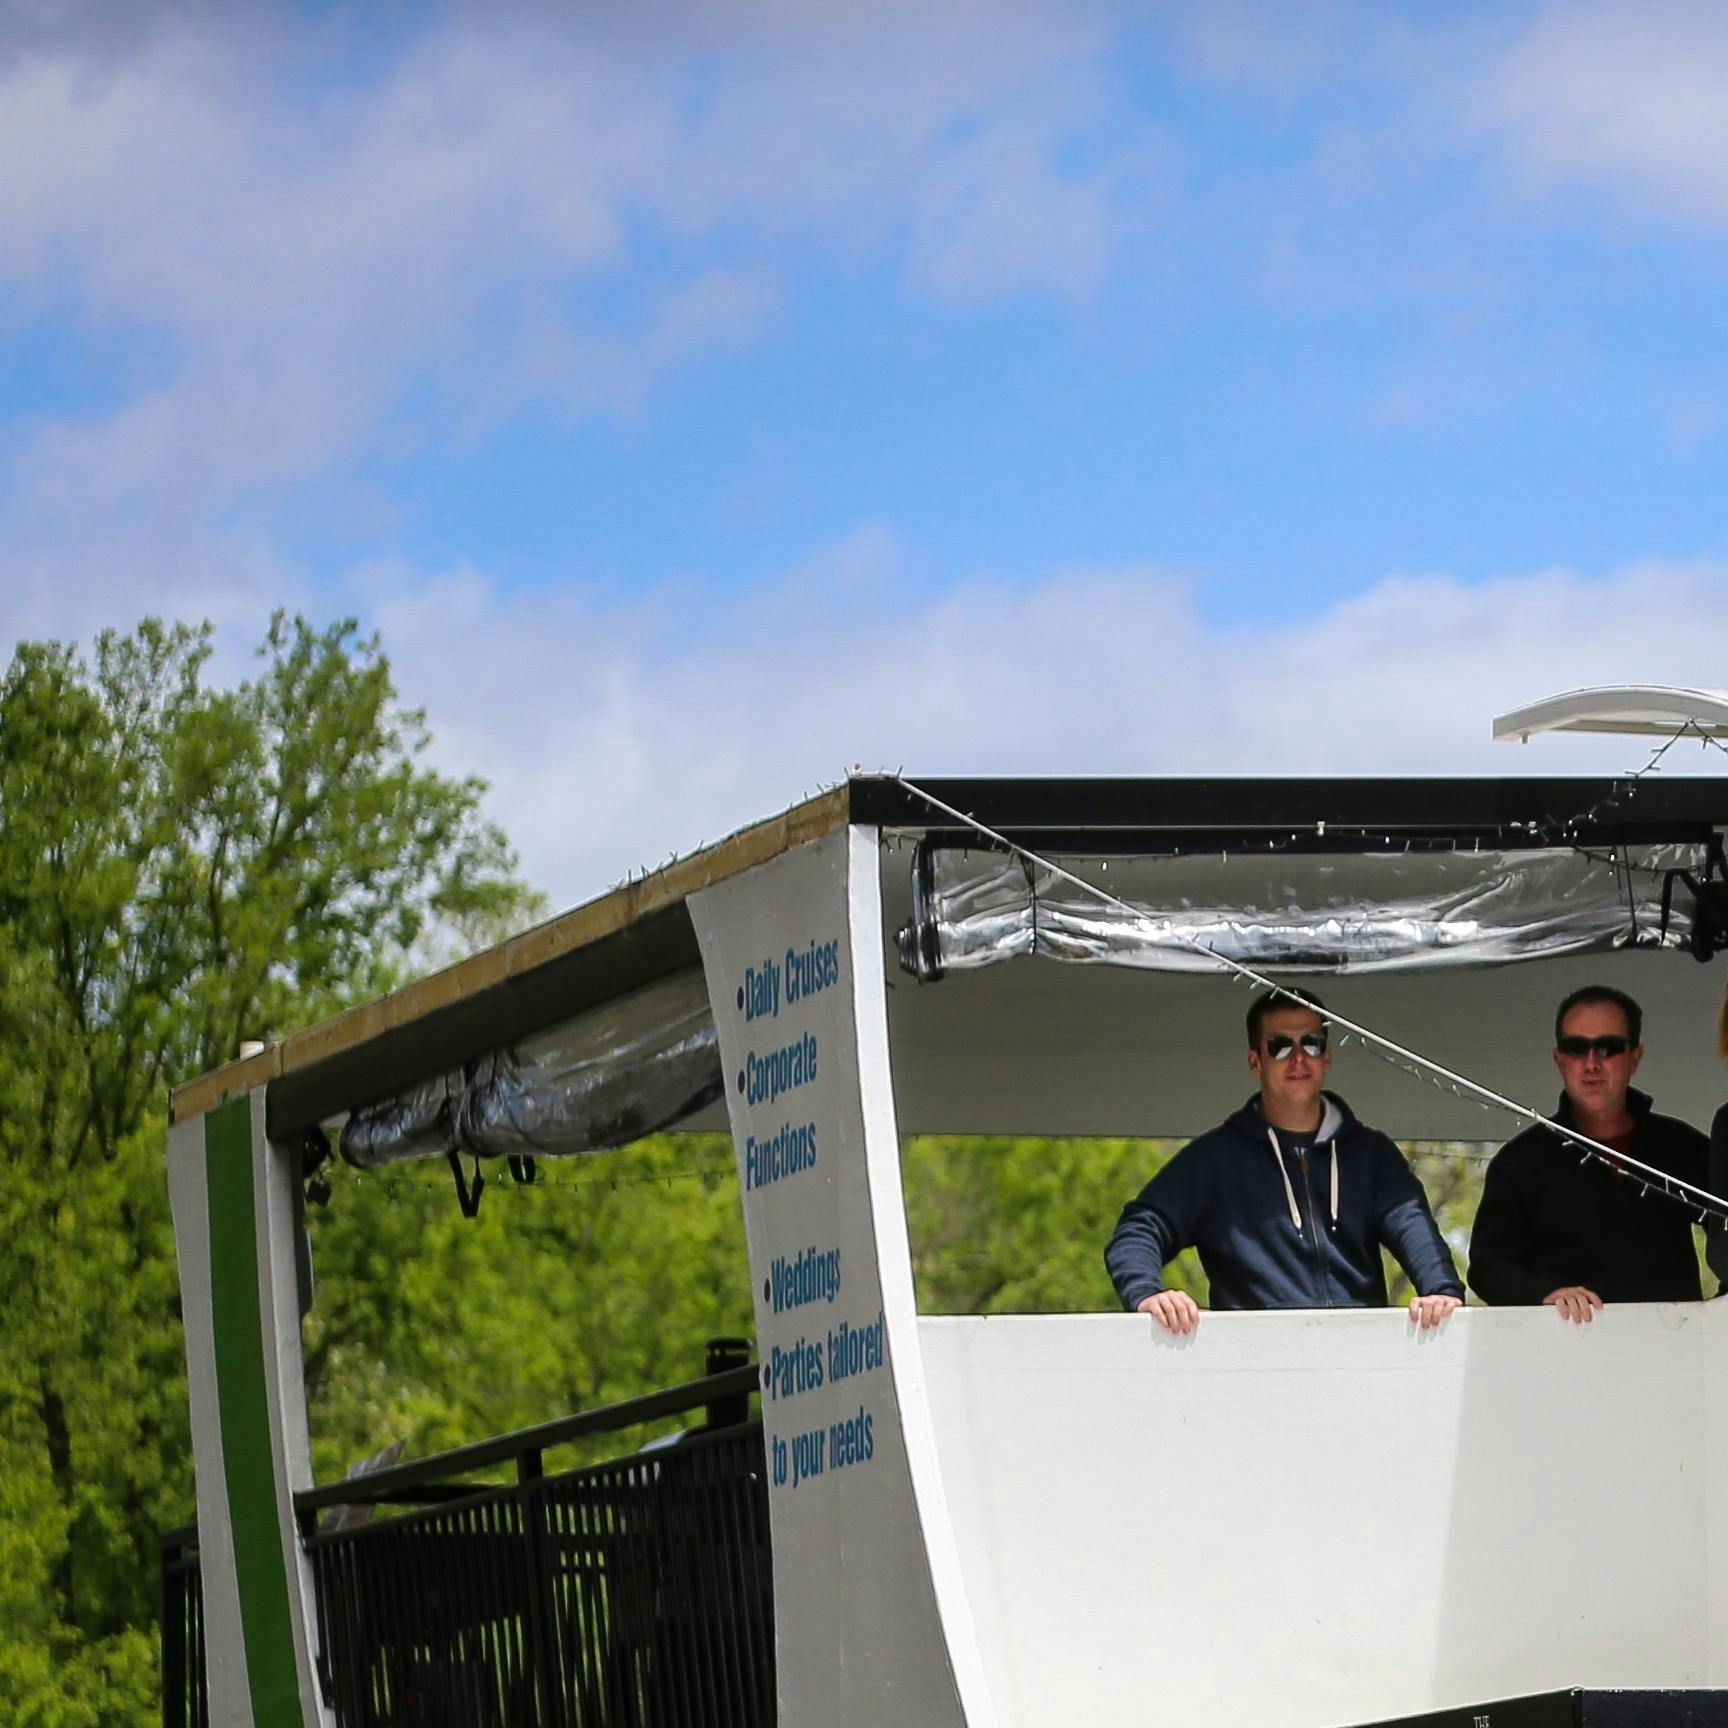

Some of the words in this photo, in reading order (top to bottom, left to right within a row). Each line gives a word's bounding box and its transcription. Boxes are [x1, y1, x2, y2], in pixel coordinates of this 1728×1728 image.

[745, 957, 780, 1021] Daily
[785, 939, 839, 1005] Cruises
[746, 1032, 817, 1106] Corporate
[746, 1122, 816, 1192] Functions
[771, 1246, 840, 1314] Weddings
[771, 1340, 824, 1400] Parties
[828, 1311, 883, 1385] tailored
[772, 1433, 787, 1486] to
[792, 1427, 826, 1489] your
[829, 1406, 873, 1469] needs
